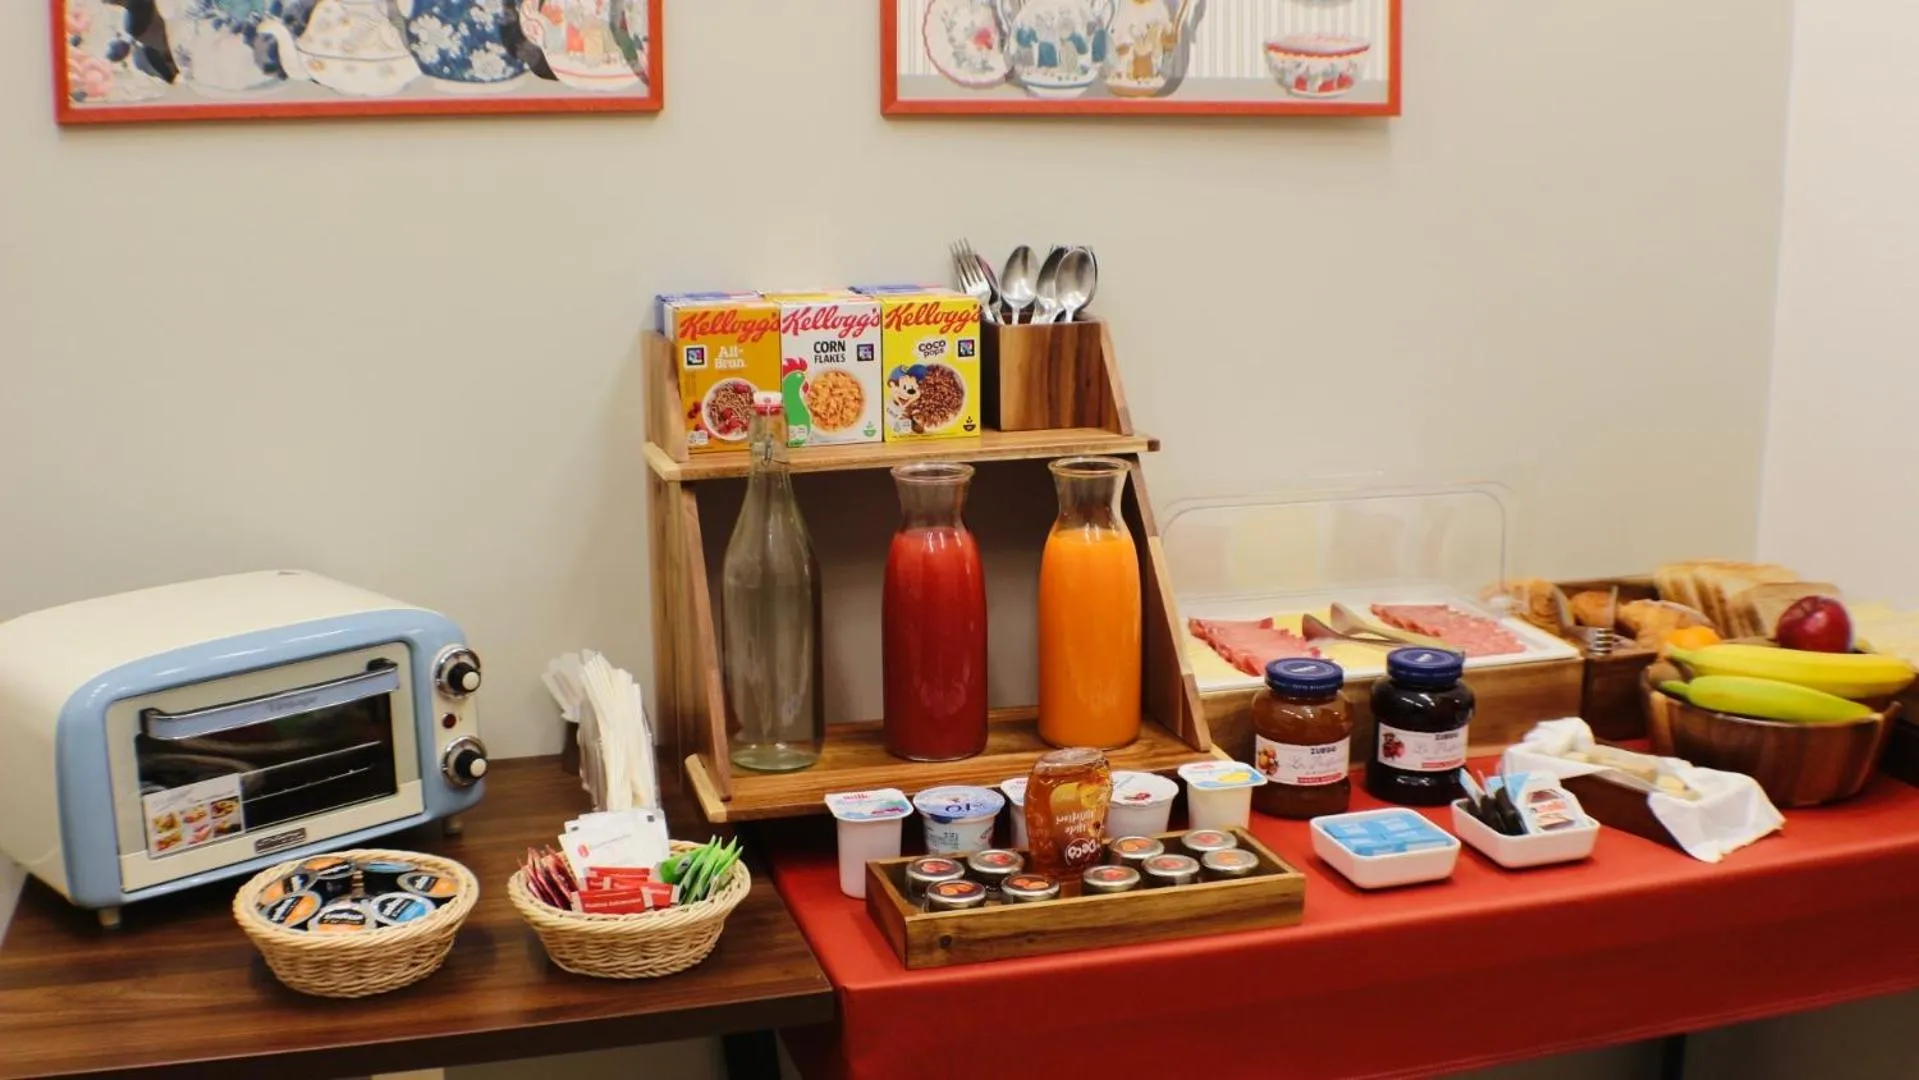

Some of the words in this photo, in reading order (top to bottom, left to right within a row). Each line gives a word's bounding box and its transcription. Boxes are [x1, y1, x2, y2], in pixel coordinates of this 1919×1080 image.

[679, 309, 781, 343] Kellogg's
[781, 305, 880, 338] Kellogg's
[885, 301, 983, 334] Kellogg's
[813, 340, 846, 353] CORN
[814, 353, 846, 364] FLAKES
